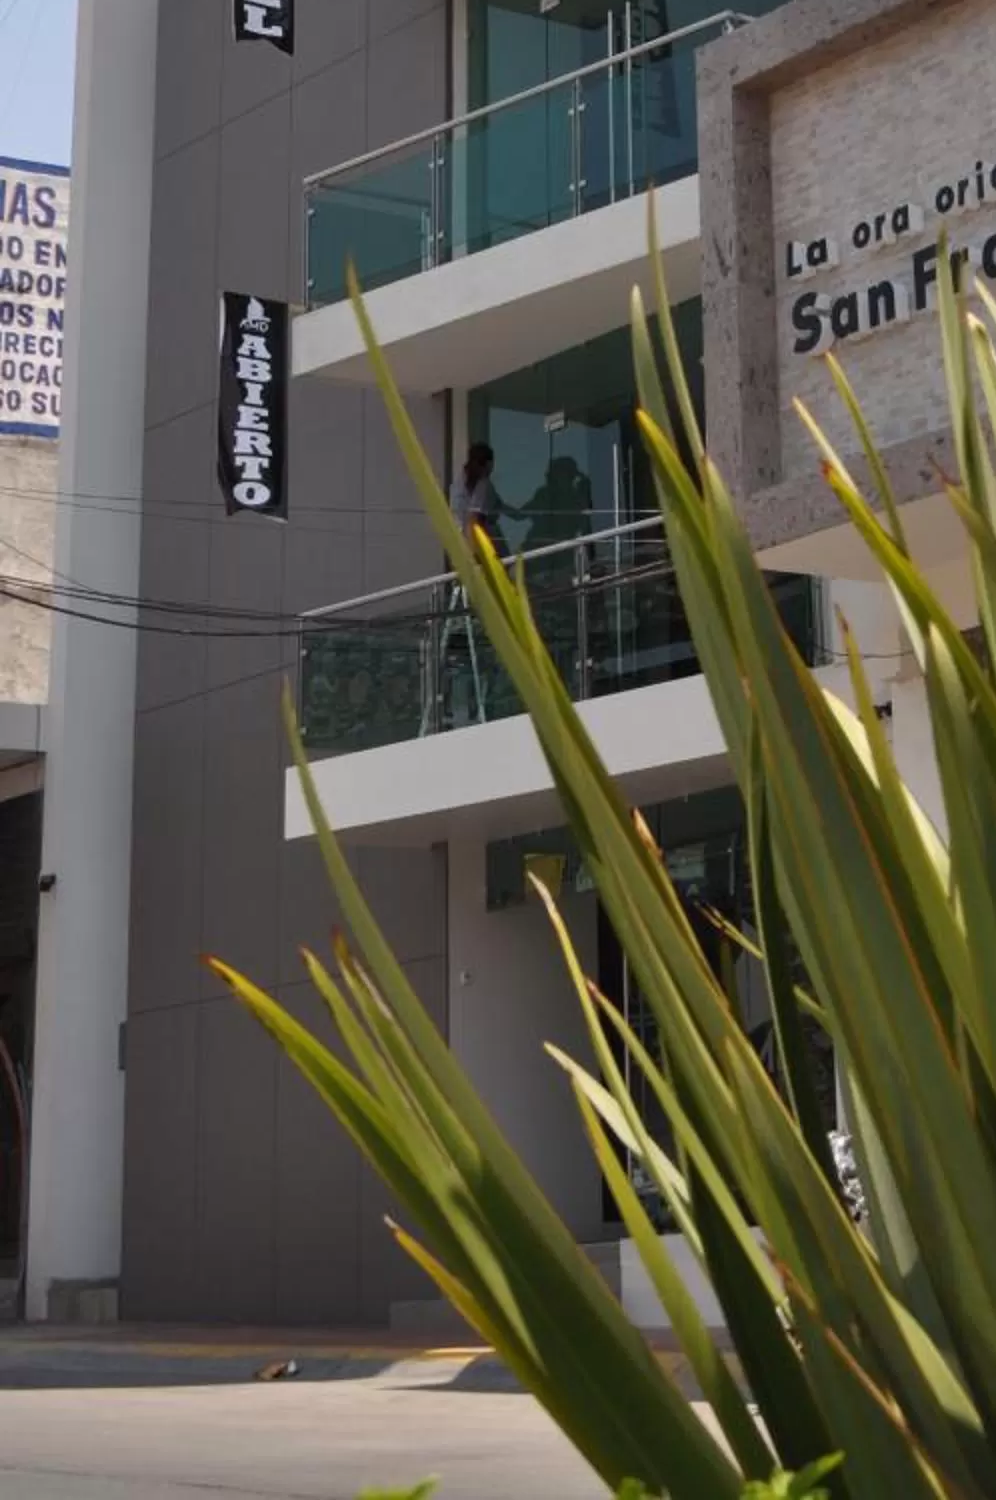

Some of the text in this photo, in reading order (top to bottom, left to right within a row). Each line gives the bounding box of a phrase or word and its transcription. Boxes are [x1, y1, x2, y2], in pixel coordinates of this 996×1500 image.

[0, 234, 24, 262] O
[793, 279, 896, 353] San
[233, 333, 273, 505] ABIERTO
